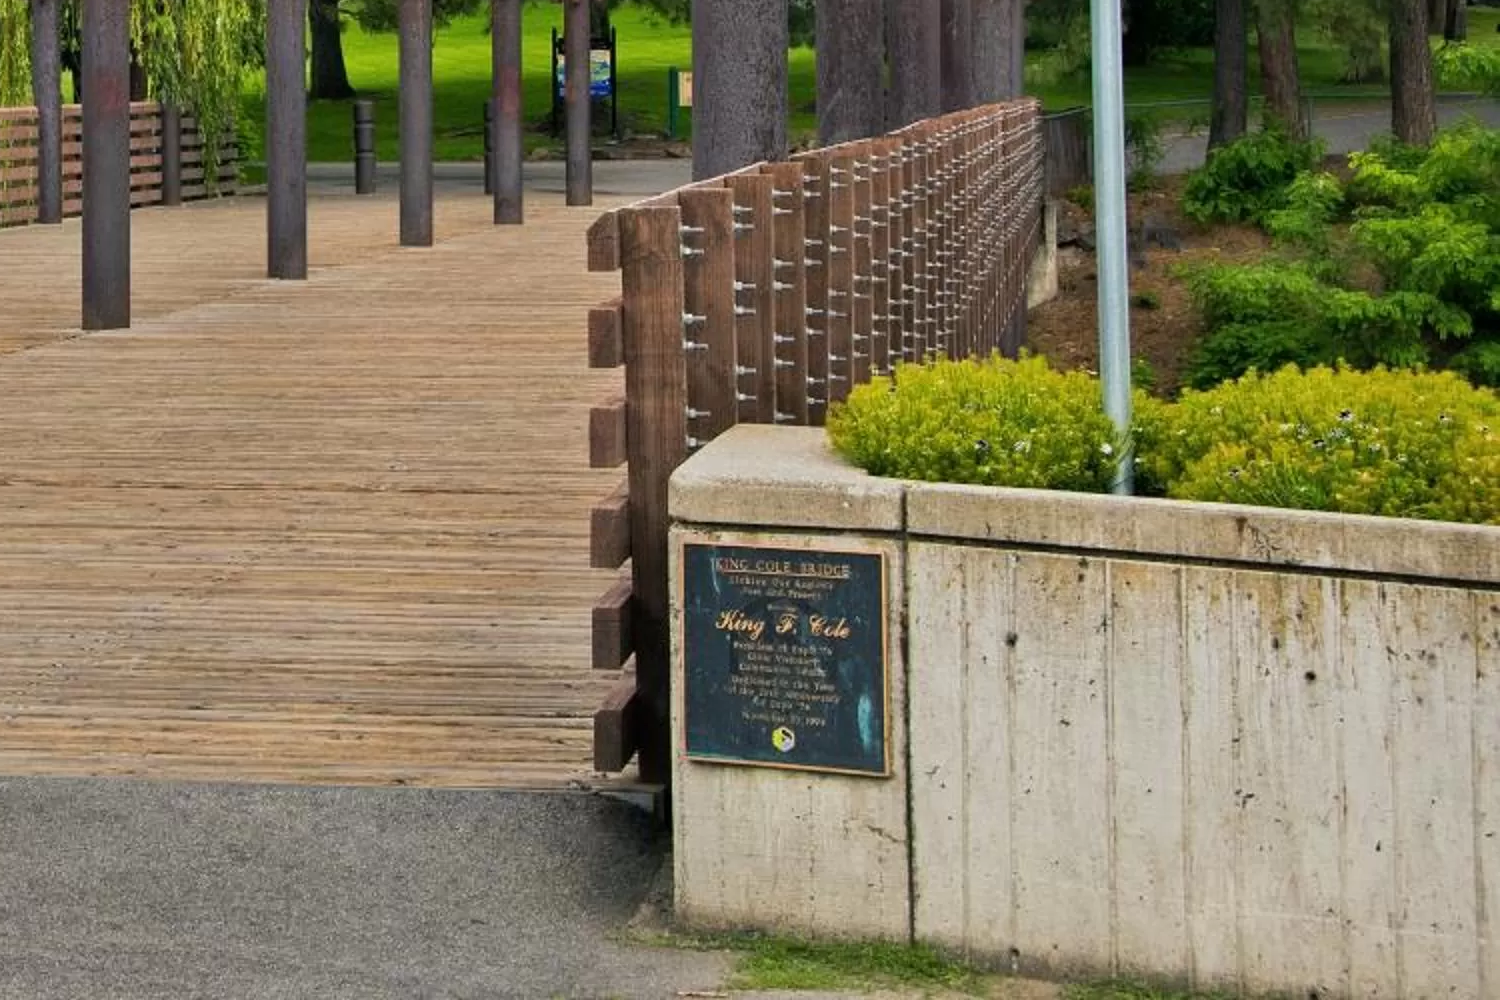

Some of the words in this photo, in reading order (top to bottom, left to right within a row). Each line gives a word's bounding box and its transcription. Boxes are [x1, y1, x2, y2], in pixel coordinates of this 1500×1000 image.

[715, 556, 749, 571] KING
[755, 559, 792, 573] COLE
[801, 562, 851, 577] BRIDGE
[715, 608, 766, 641] King
[808, 613, 852, 640] Cole
